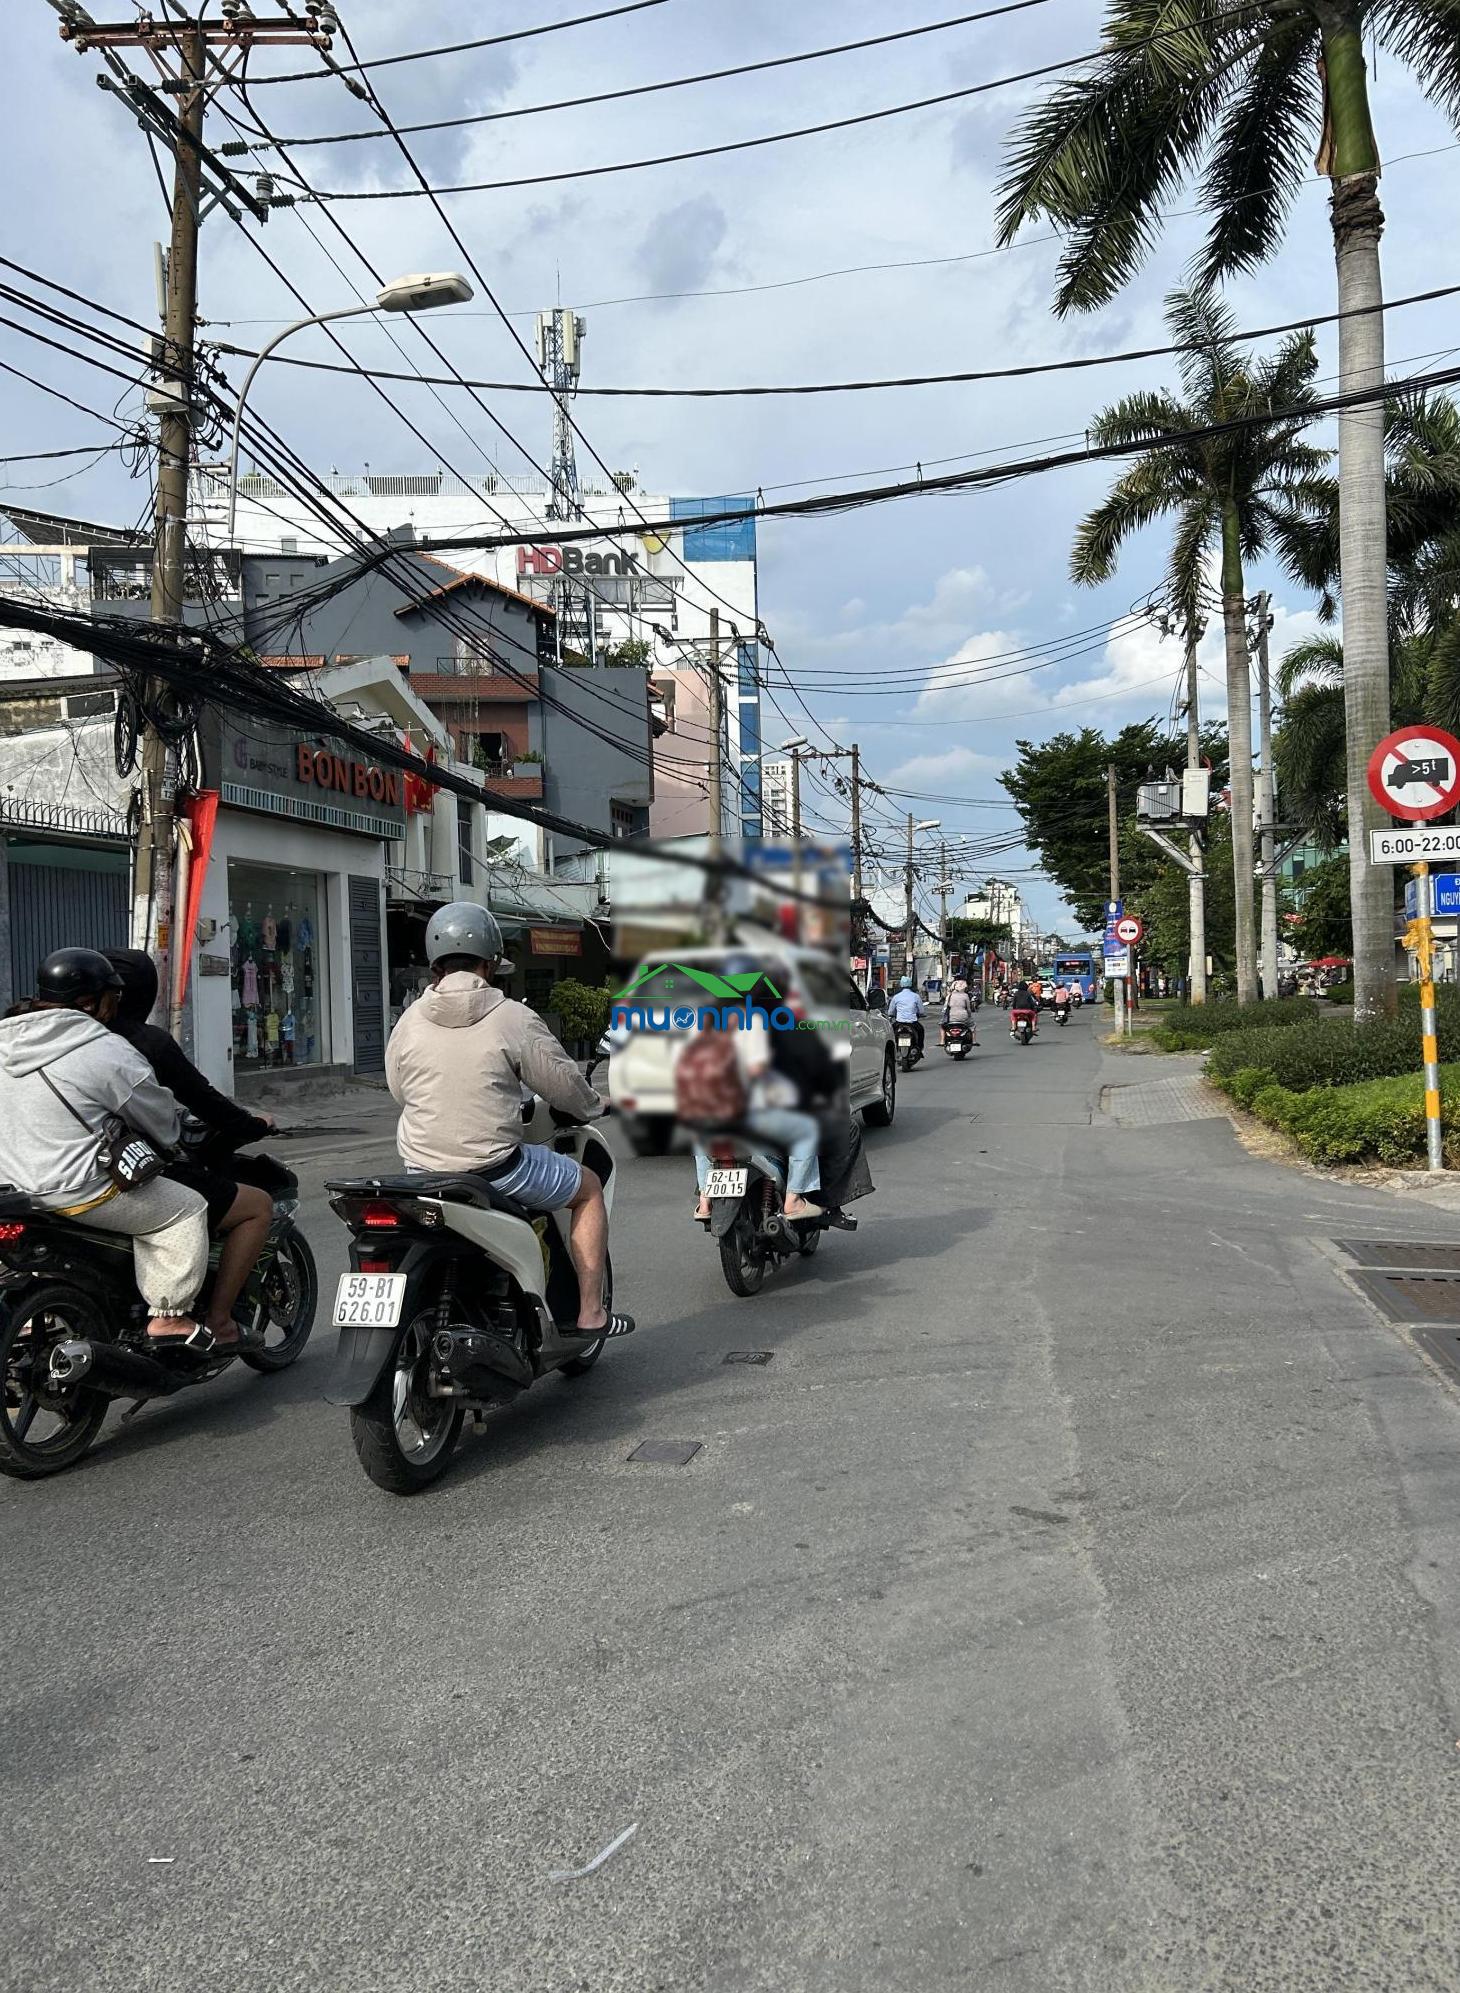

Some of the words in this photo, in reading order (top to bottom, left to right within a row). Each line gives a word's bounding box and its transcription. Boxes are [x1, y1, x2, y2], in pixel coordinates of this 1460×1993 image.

[517, 546, 639, 575] HDBank
[348, 1278, 394, 1299] 59-B1
[338, 1301, 396, 1323] 626.01
